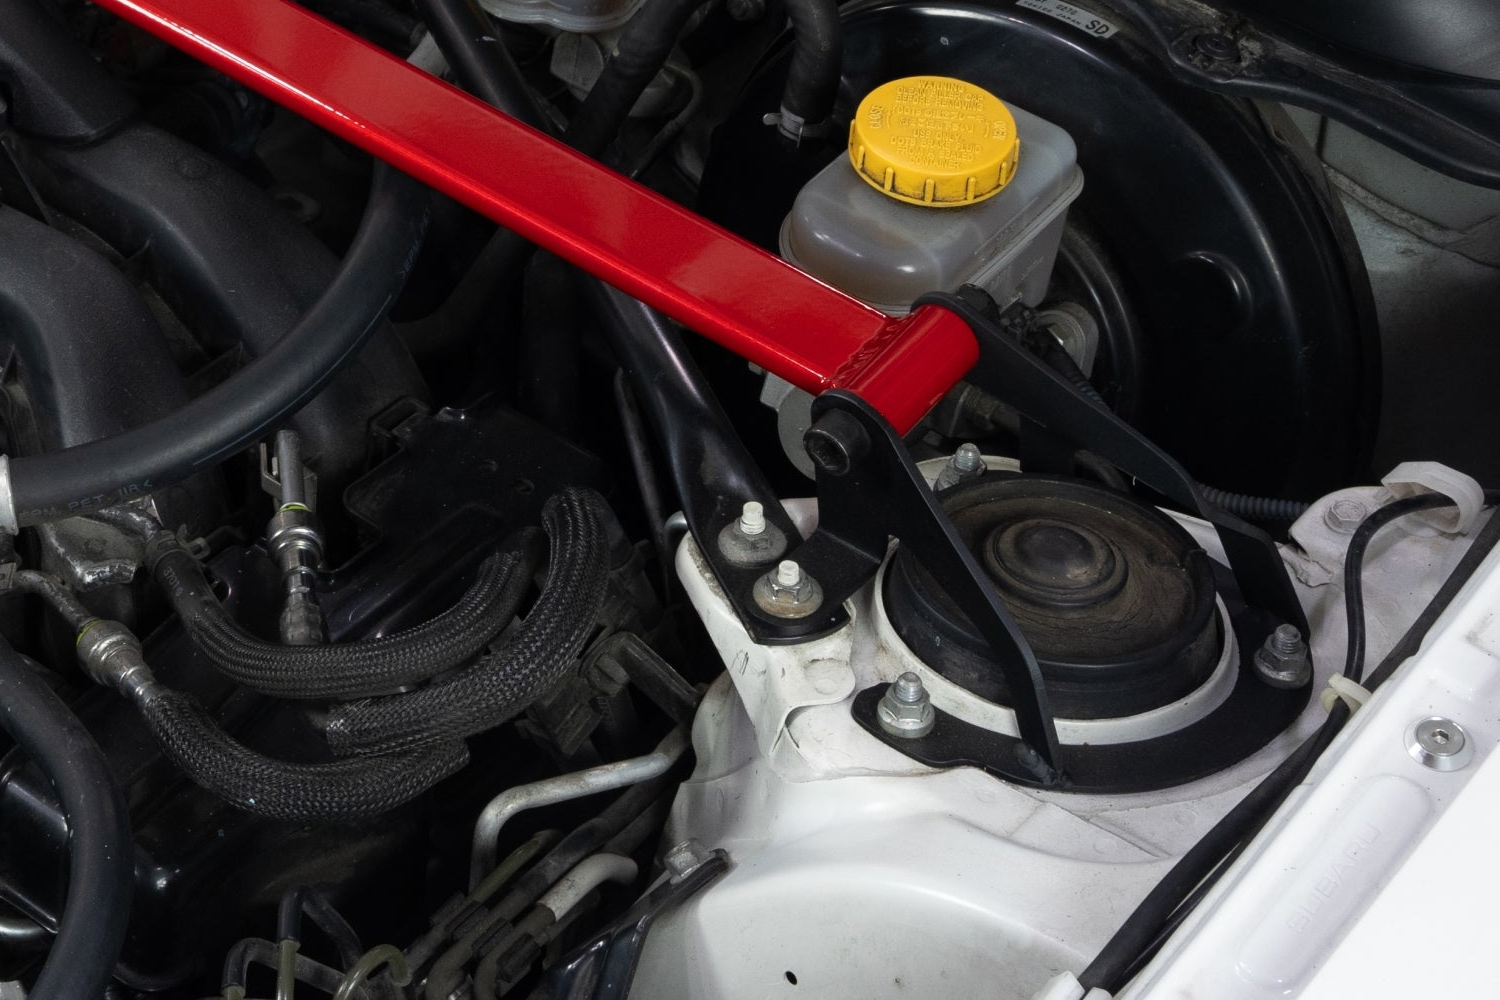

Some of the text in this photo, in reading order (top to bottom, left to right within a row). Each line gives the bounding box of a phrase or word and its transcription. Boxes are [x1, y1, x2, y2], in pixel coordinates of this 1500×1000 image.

[1085, 20, 1110, 35] SD
[897, 86, 983, 102] CLEAN FILLER CAP
[918, 80, 965, 93] WARNING
[896, 94, 983, 111] BEFORE REMOVING
[914, 129, 931, 139] USE
[896, 145, 923, 157] FROM
[940, 150, 974, 162] SEALED
[921, 138, 951, 150] BRAKE
[955, 142, 981, 154] FLUID
[909, 156, 960, 169] CONTAINER
[68, 494, 105, 511] PET
[1285, 821, 1381, 934] SUBARU
